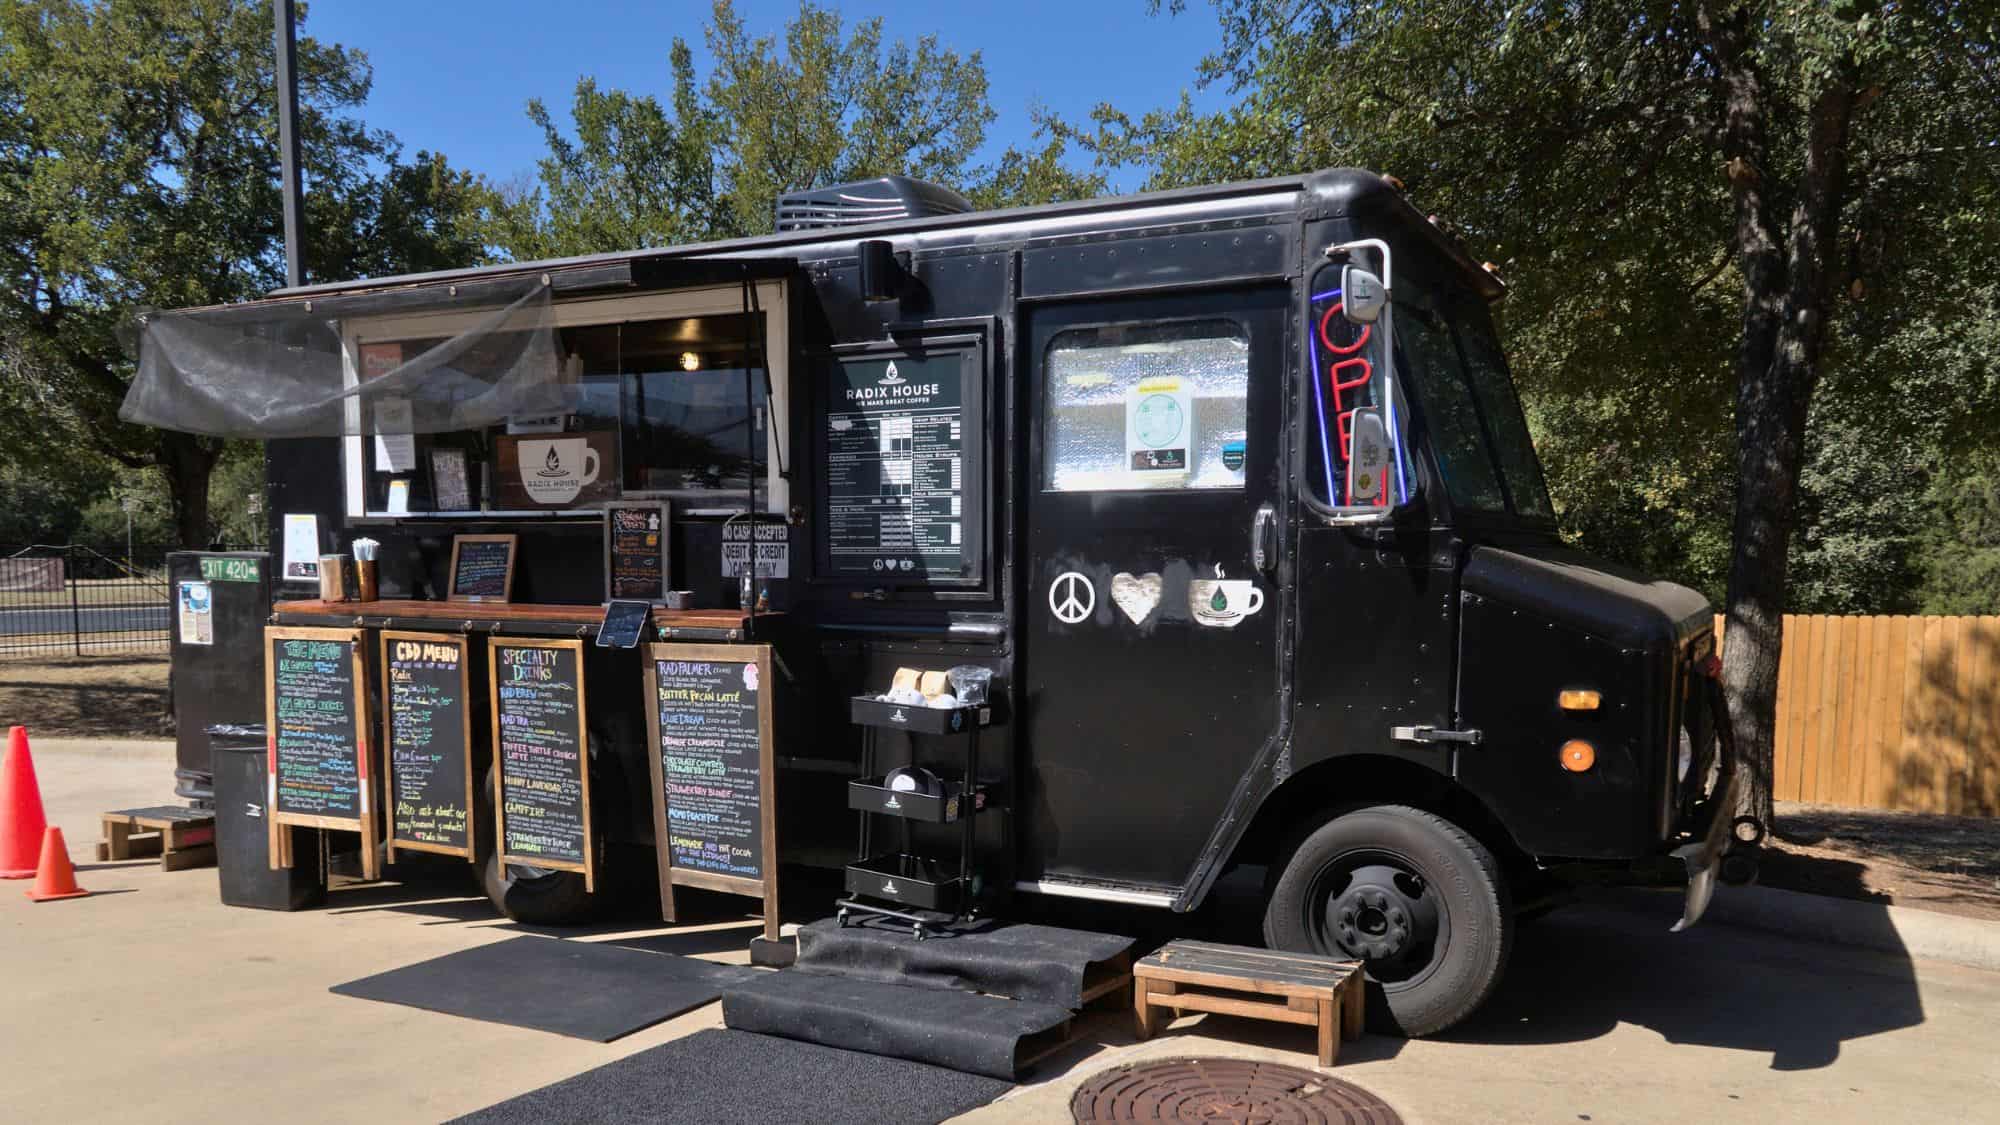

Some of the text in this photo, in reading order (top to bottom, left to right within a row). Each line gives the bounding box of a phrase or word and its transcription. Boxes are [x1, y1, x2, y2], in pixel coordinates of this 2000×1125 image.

[846, 383, 939, 400] RADIX HOUSE
[733, 525, 751, 540] CASH
[754, 525, 788, 540] ACCEPTED
[726, 545, 748, 560] DEBIT
[761, 545, 786, 560] CREDIT
[201, 560, 249, 579] EXIT 420
[396, 642, 459, 663] CBD MENU
[503, 649, 558, 666] SPECIALTY
[513, 664, 552, 680] DRINKS
[658, 661, 677, 675] RAD
[678, 662, 712, 676] PALMER
[659, 687, 689, 701] BUTTER
[690, 689, 714, 703] PECAN
[502, 741, 528, 752] TOFFEE
[665, 782, 707, 796] STRAWBERRY
[505, 802, 545, 817] CAMPFIRE
[670, 835, 704, 850] LEMONADE
[731, 847, 753, 858] COCOA
